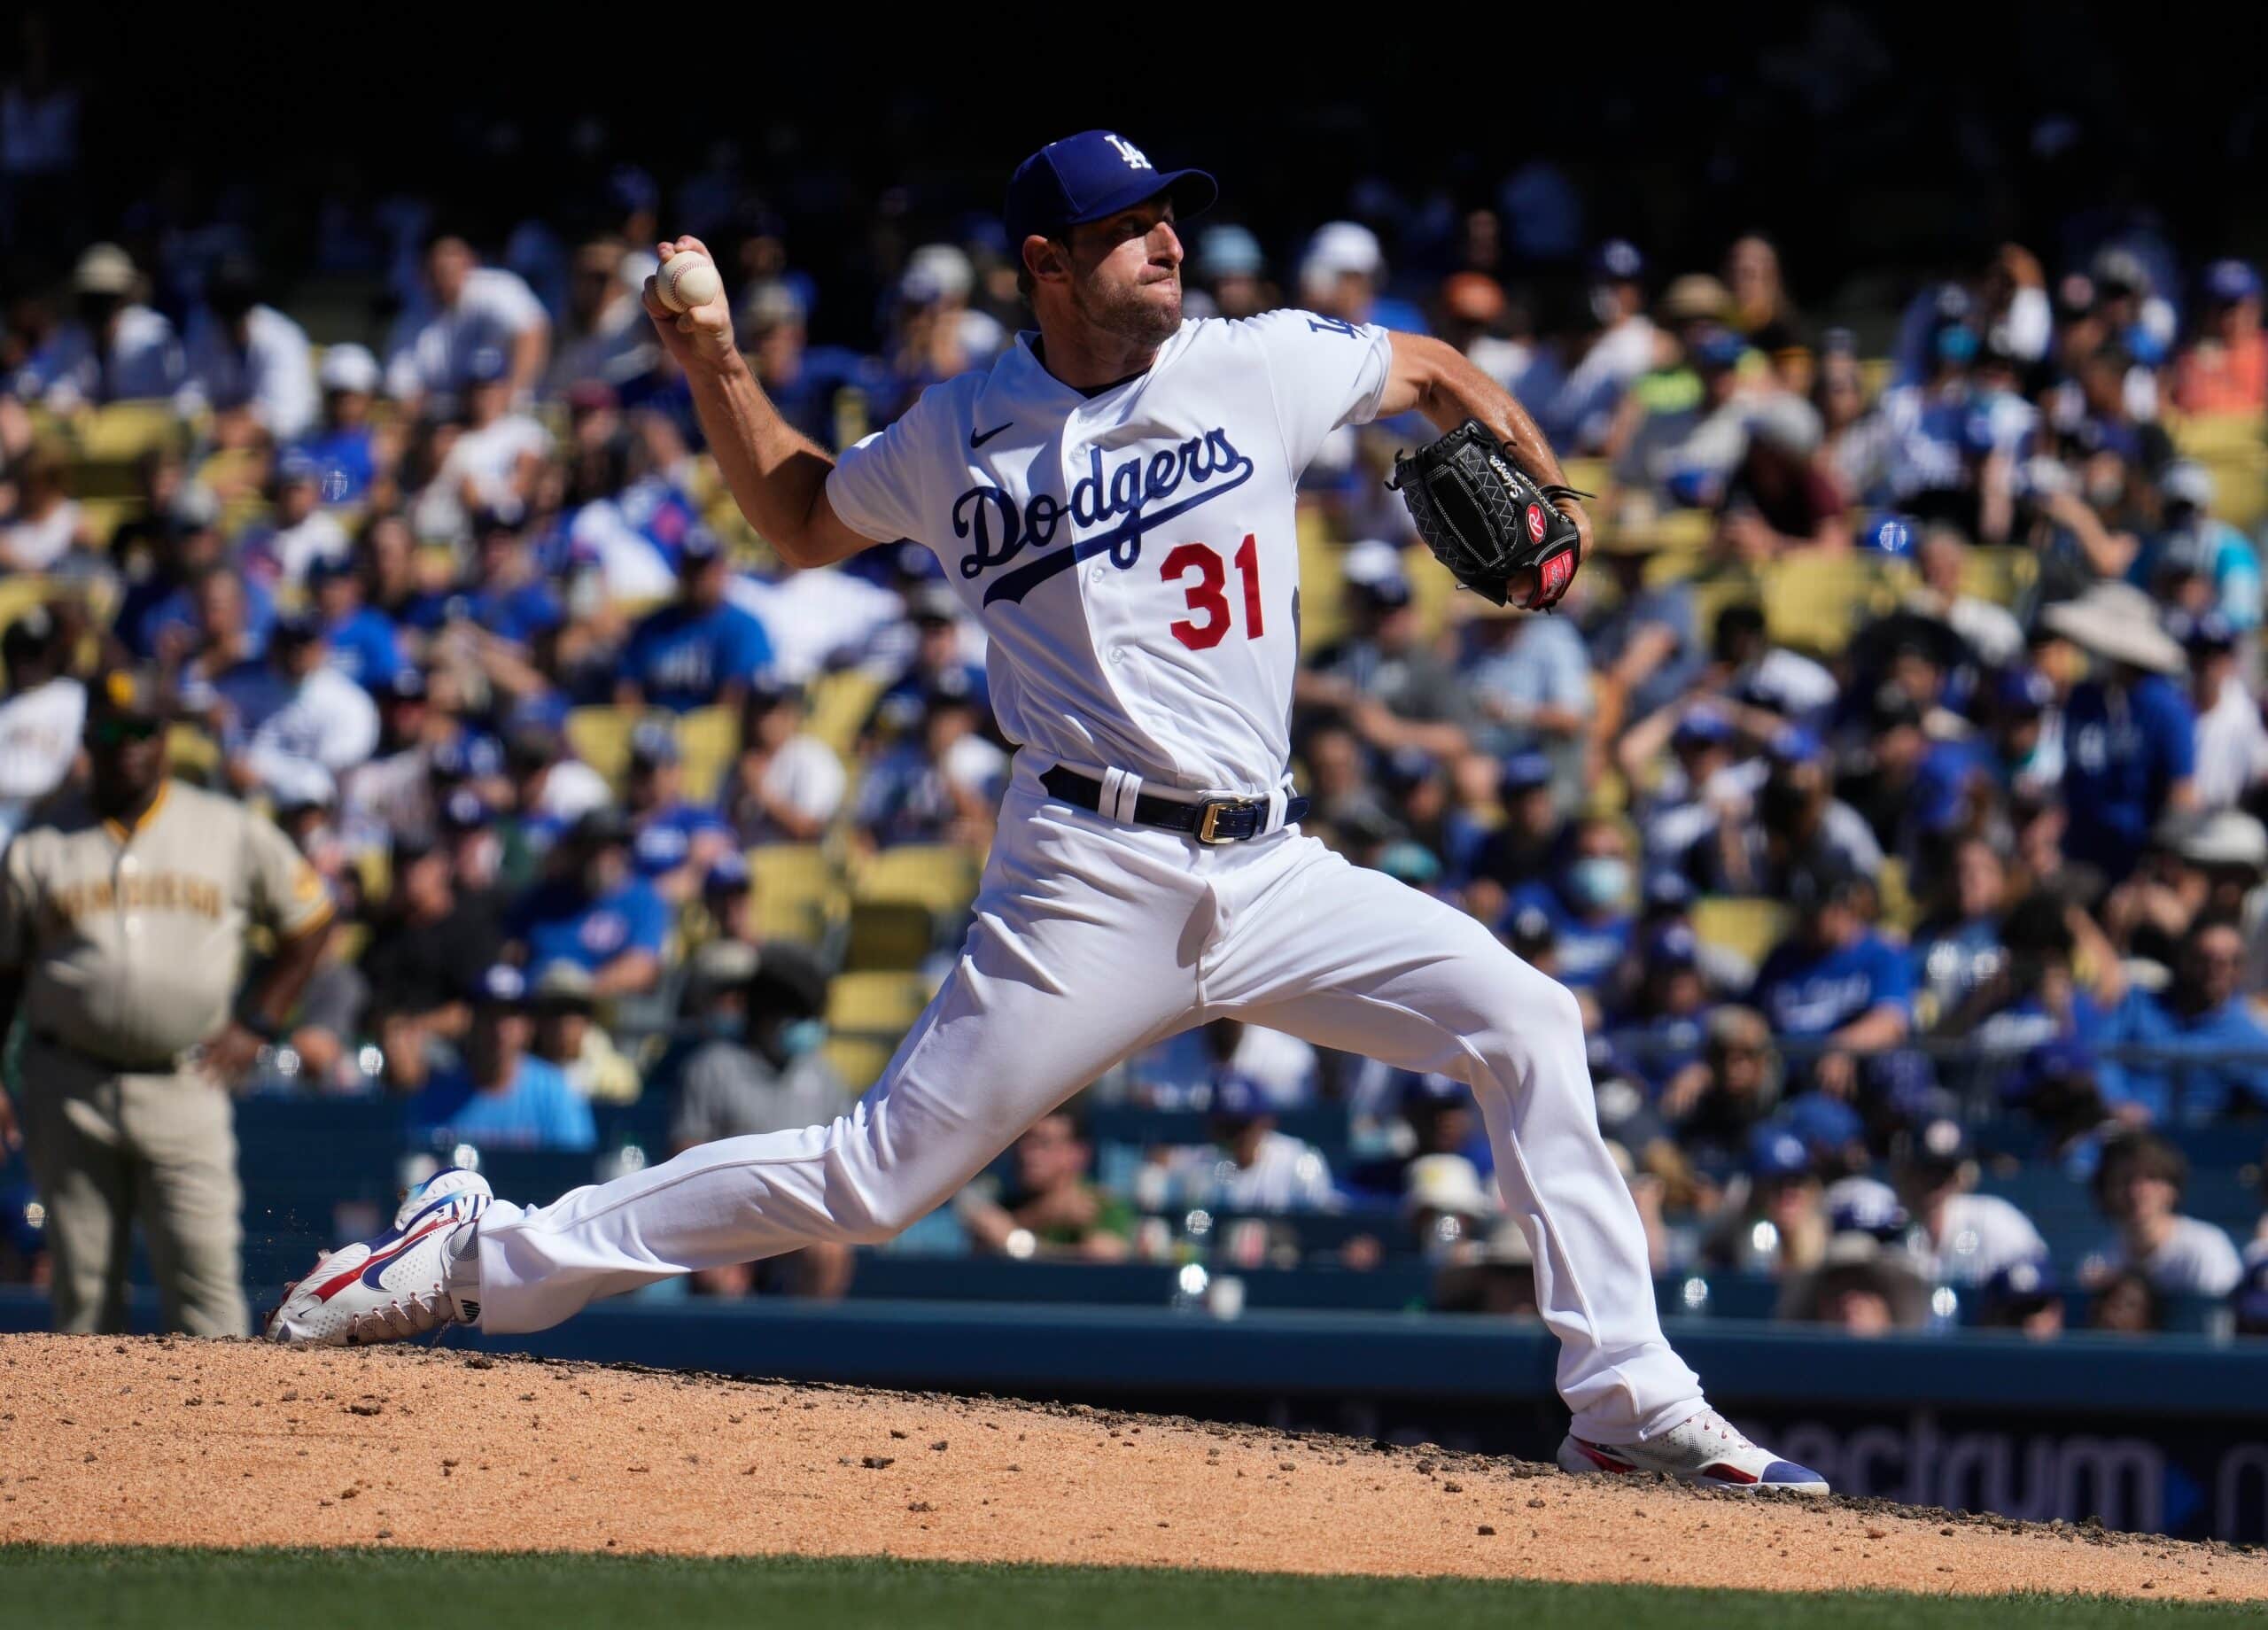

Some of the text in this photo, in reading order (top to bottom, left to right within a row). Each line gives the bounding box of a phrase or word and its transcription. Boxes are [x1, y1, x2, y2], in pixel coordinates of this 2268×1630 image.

[1104, 134, 1152, 169] LA
[952, 427, 1254, 581] Dodgers
[1160, 532, 1263, 650] 31
